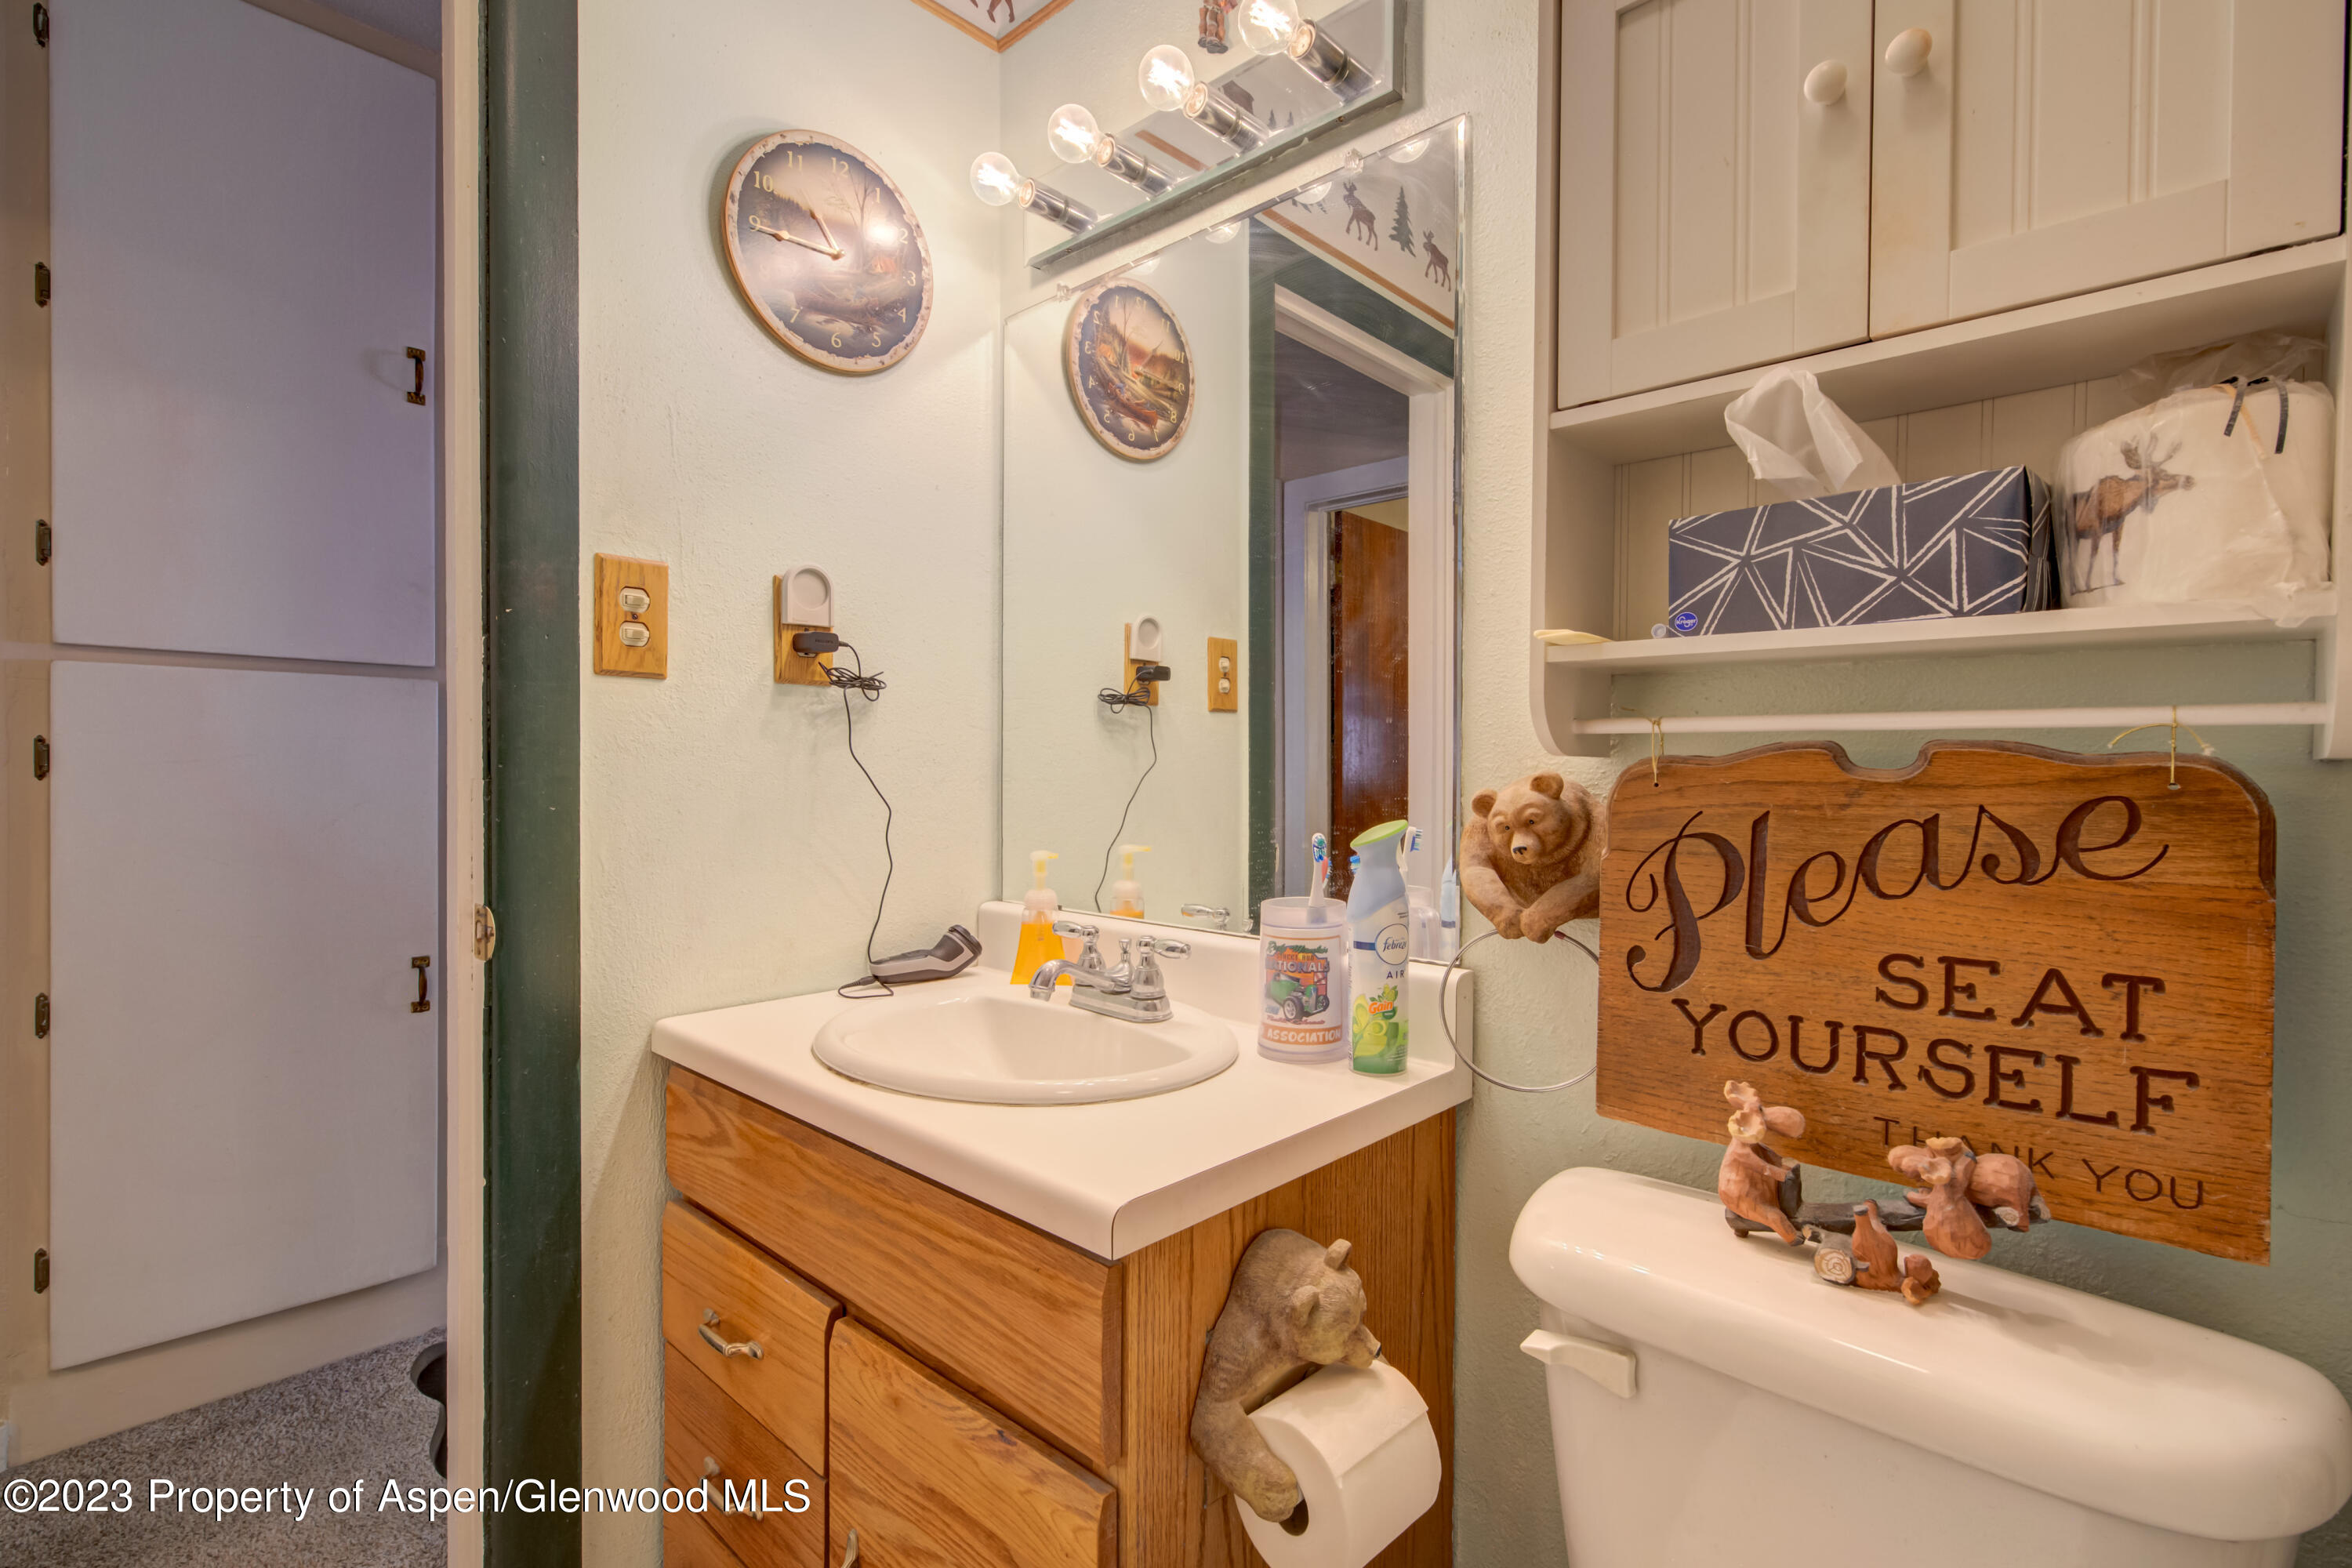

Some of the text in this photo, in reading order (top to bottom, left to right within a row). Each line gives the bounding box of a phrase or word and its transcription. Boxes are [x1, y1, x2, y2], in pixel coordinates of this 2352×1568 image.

[787, 151, 803, 172] 11
[831, 157, 849, 177] 12
[753, 171, 774, 193] 10
[874, 188, 881, 203] 1
[748, 215, 761, 232] 9
[899, 228, 909, 244] 2
[906, 270, 916, 286] 3
[790, 307, 801, 323] 7
[897, 307, 906, 323] 4
[831, 332, 842, 347] 6
[872, 332, 881, 347] 5
[1675, 615, 1697, 628] Kroger
[1626, 795, 2169, 992] Please
[1386, 970, 1405, 979] AIR
[1876, 953, 2166, 1043] SEAT
[1368, 1000, 1394, 1015] Gain
[1266, 1028, 1342, 1044] ASSOCIATION
[1671, 998, 2201, 1135] YOURSELF
[2082, 1158, 2204, 1210] YOU
